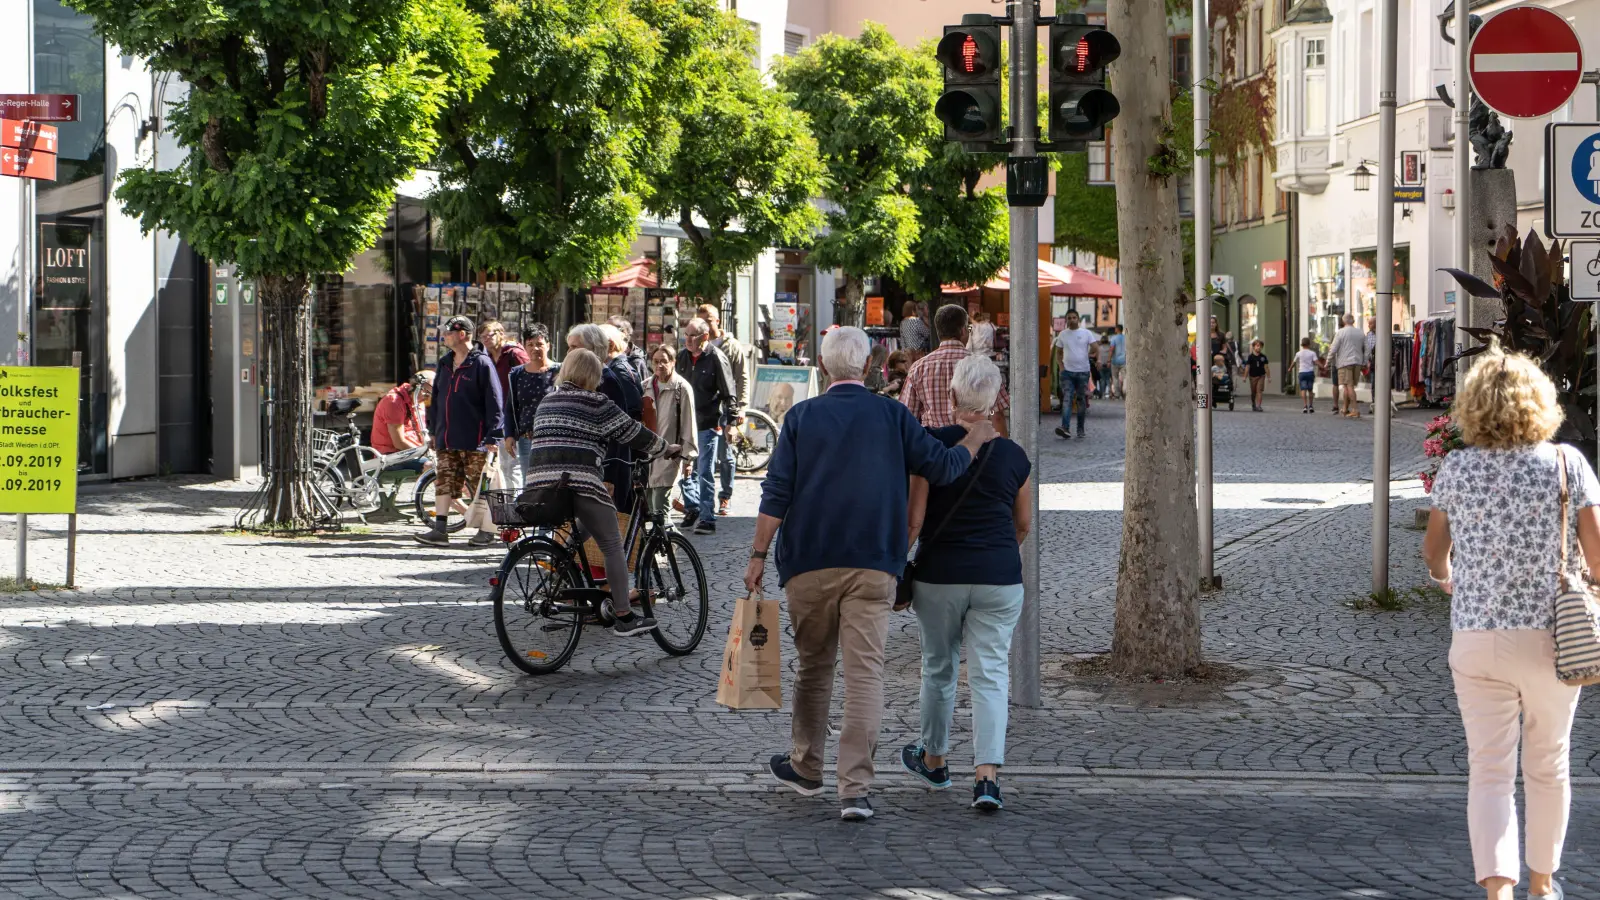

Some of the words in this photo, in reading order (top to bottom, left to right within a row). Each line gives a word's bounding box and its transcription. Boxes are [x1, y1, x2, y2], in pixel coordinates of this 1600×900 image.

[46, 248, 86, 268] LOFT
[0, 385, 59, 398] olksfest
[0, 406, 71, 419] braucher-
[2, 425, 47, 435] messe
[16, 441, 38, 449] Weiden
